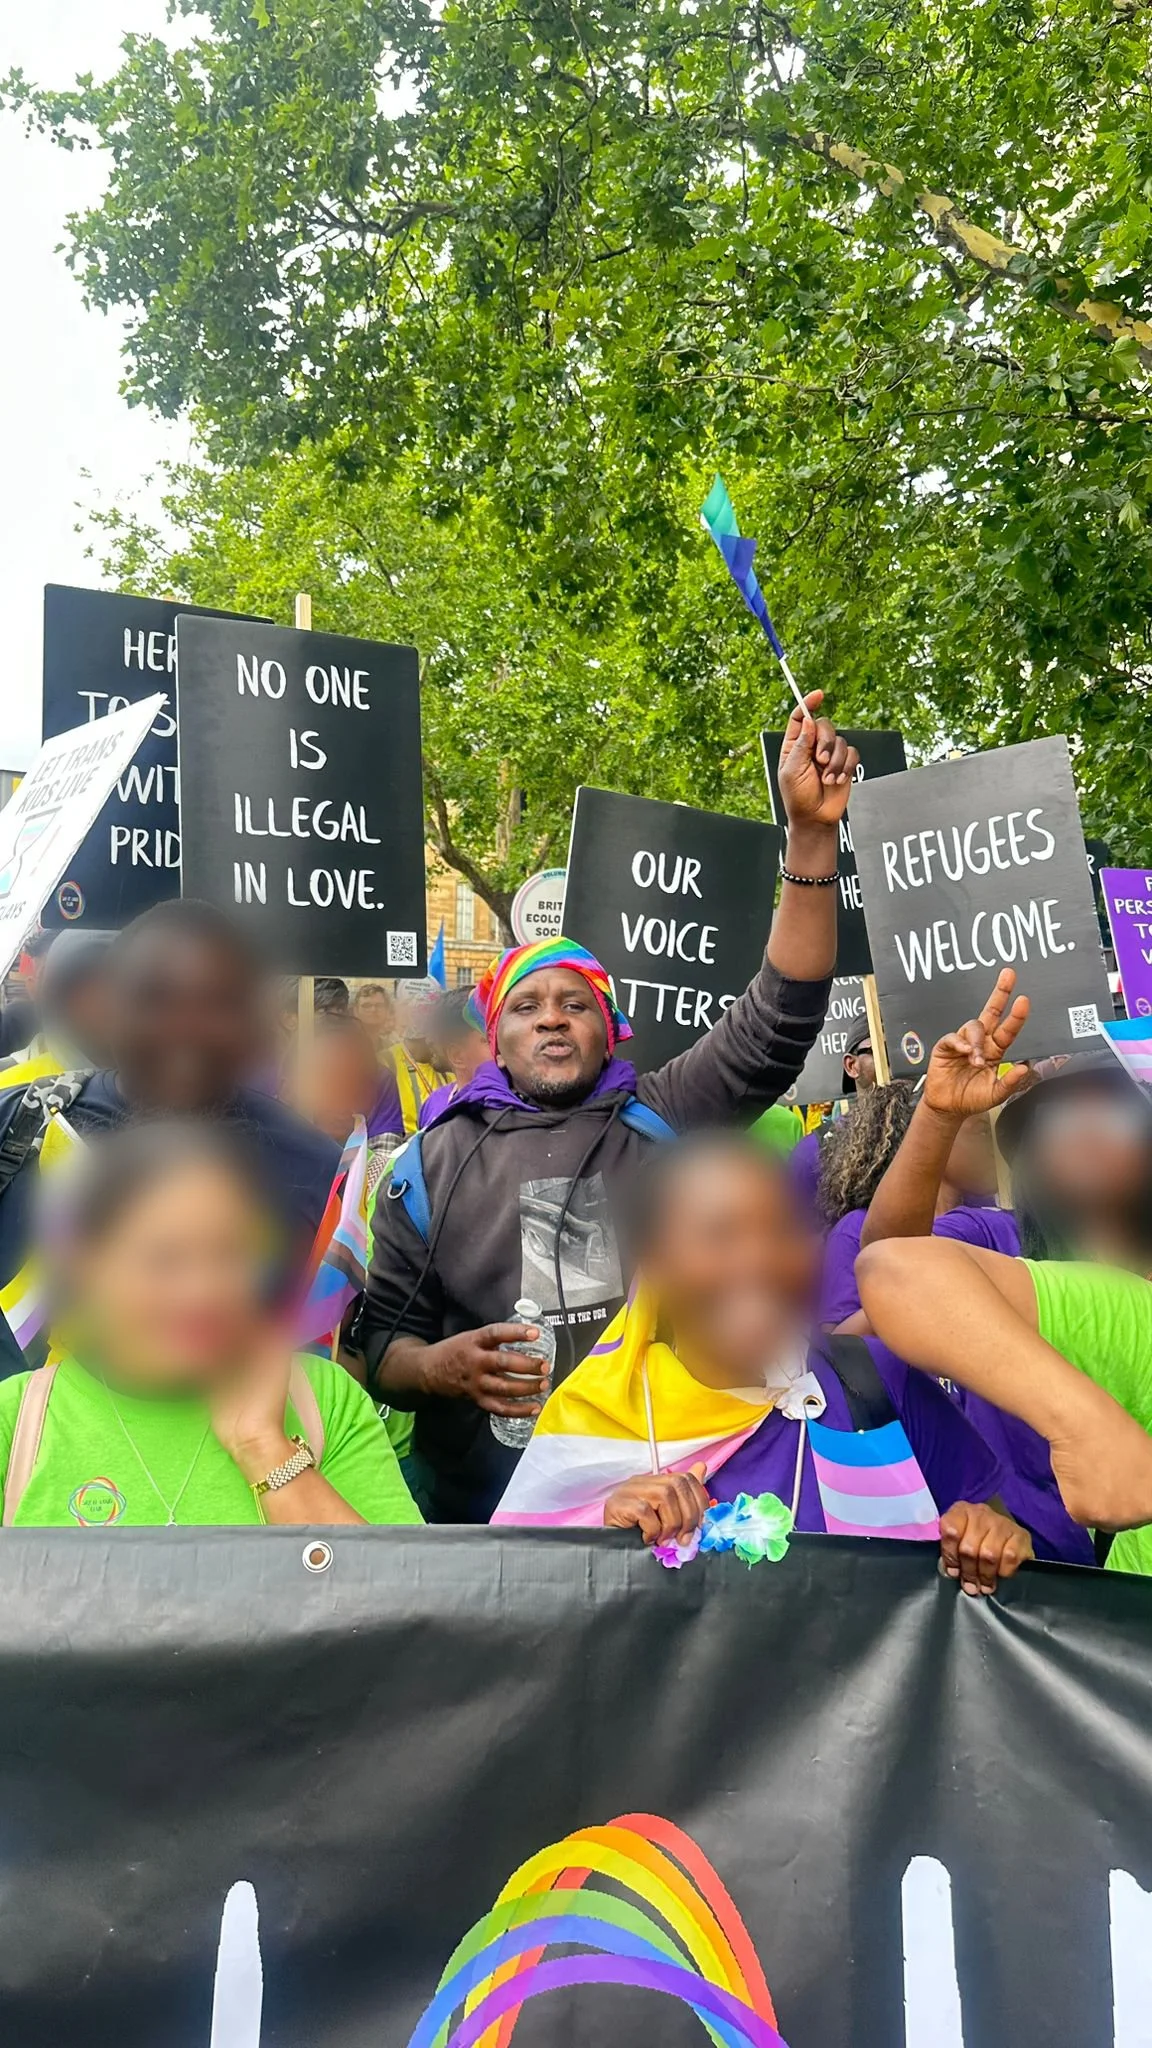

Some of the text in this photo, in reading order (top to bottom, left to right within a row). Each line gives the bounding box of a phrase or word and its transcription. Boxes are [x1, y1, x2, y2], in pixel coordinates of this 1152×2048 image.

[236, 653, 370, 710] NO ONE
[31, 730, 124, 786] LET TRANS
[289, 728, 327, 770] IS
[15, 765, 100, 817] KIDS LIVE
[234, 792, 381, 844] ILLEGAL
[110, 825, 180, 868] PRID
[882, 808, 1056, 893] REFUGEES
[233, 861, 385, 910] IN LOVE.
[631, 850, 703, 899] OUR
[526, 913, 561, 924] ECOLO
[621, 911, 719, 964] VOICE
[894, 899, 1076, 983] WELCOME.
[577, 1311, 592, 1323] THE
[593, 1308, 607, 1320] USA
